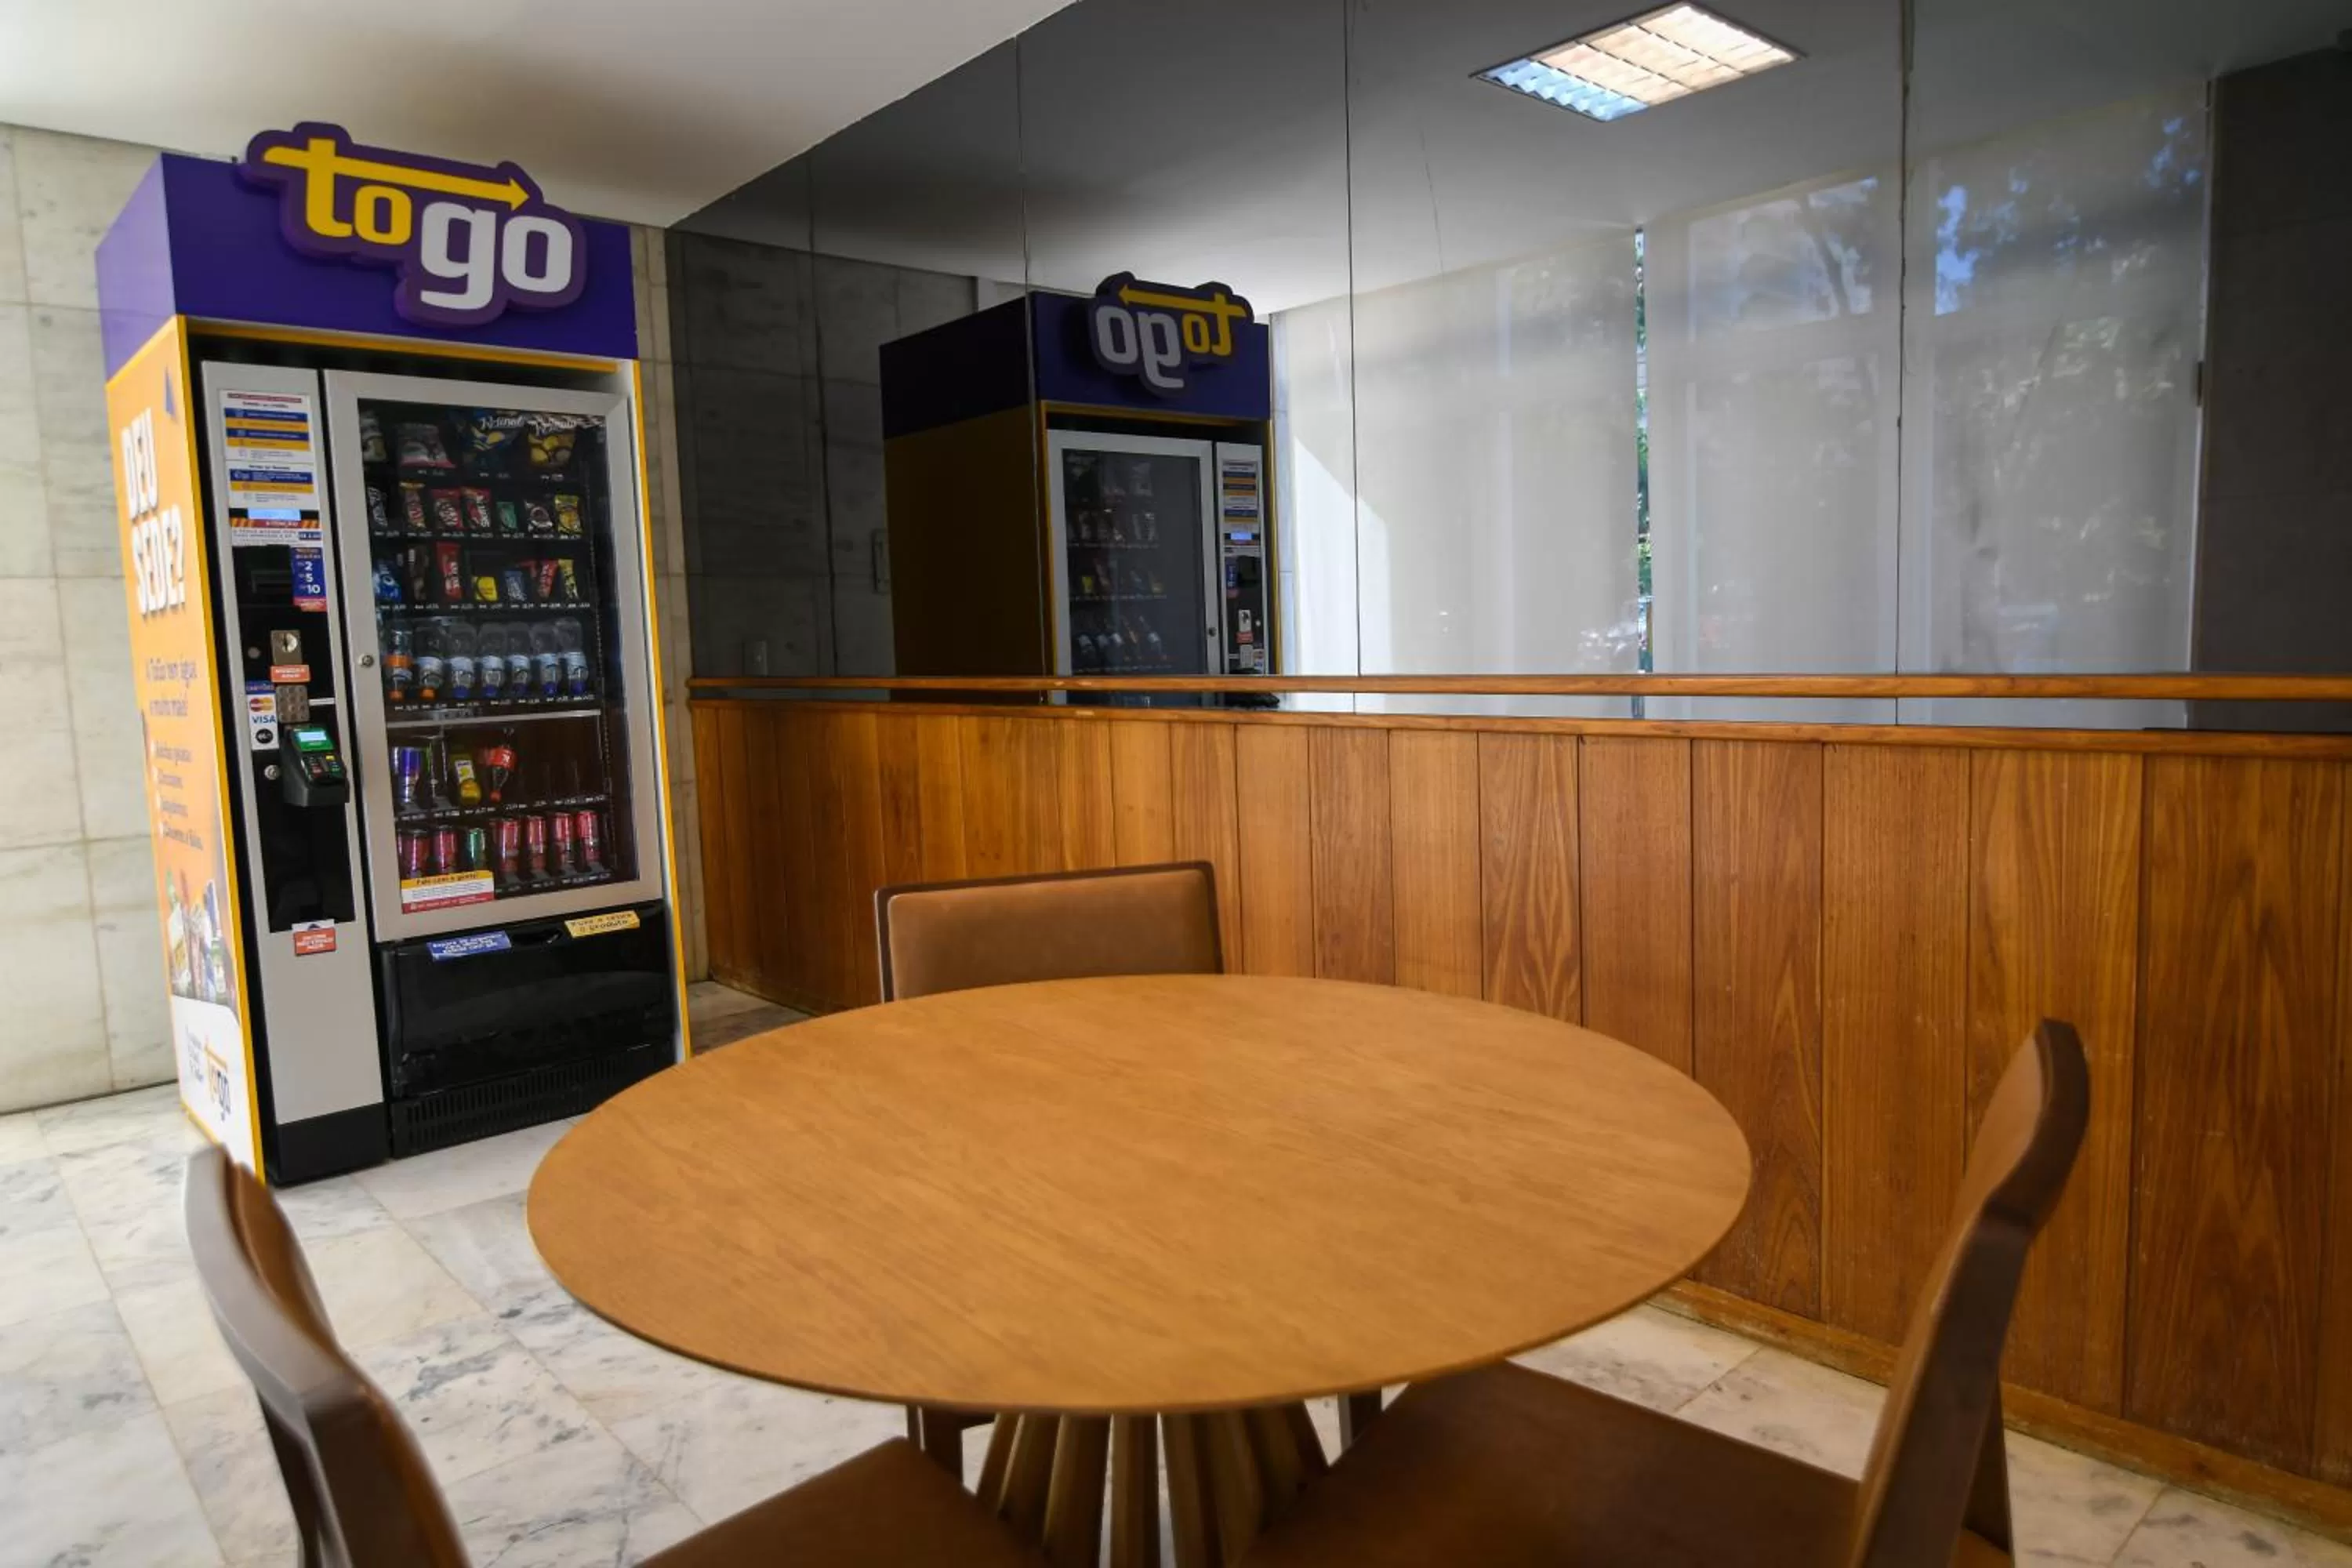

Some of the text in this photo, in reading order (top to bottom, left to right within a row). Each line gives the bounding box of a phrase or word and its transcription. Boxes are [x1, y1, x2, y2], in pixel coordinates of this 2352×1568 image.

[121, 408, 158, 521] DEU
[132, 504, 187, 615] SEDE?
[304, 561, 313, 572] 2
[305, 573, 314, 583] 5
[307, 584, 321, 594] 10
[252, 714, 277, 724] VISA
